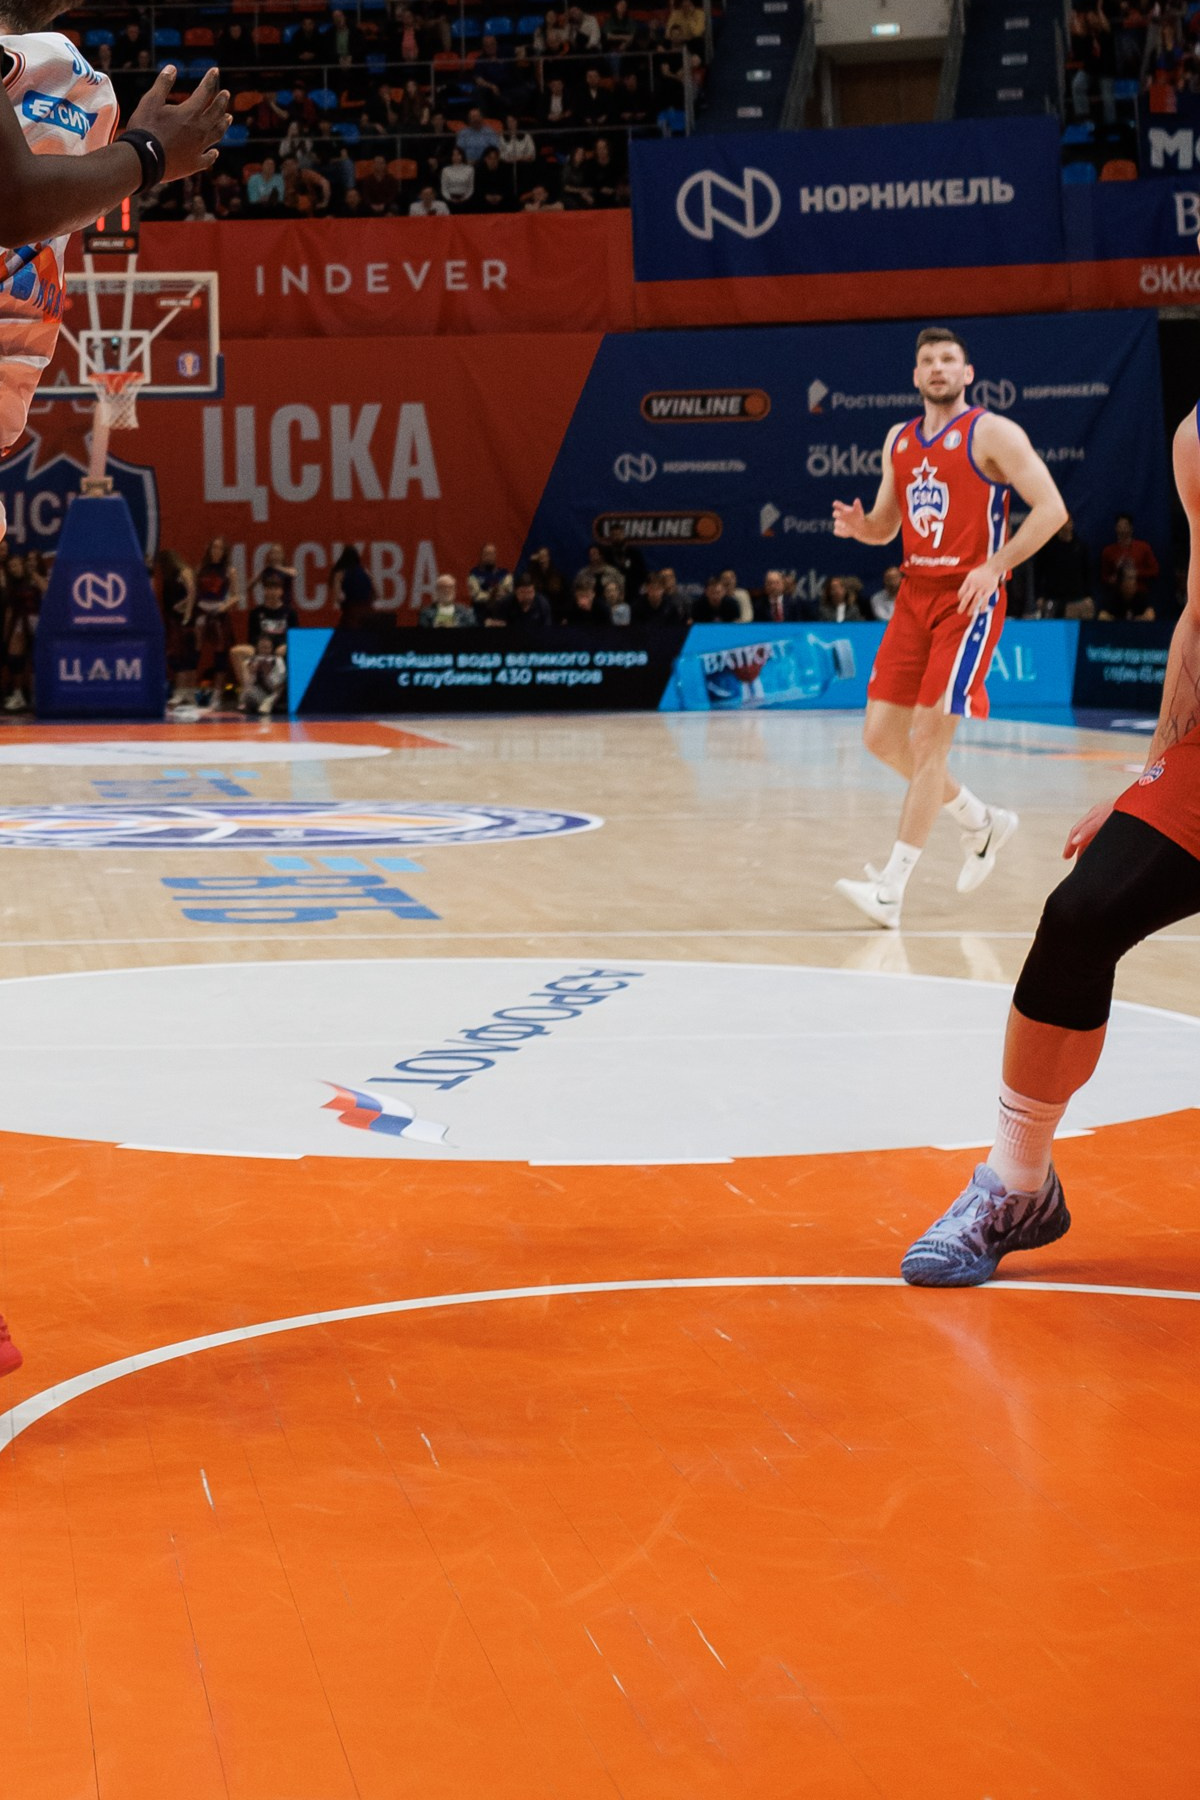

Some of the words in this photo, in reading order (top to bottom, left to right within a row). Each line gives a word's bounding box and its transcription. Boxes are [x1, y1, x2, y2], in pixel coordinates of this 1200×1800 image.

[800, 176, 1015, 213] НОРНИКЕЛЬ
[256, 258, 509, 296] INDEVER
[650, 396, 742, 417] WINLINE
[202, 402, 442, 523] ЦСКА
[930, 522, 944, 549] 7
[59, 658, 142, 683] ЦАМ
[352, 651, 453, 669] Чистейшая
[456, 653, 501, 669] вода
[505, 652, 590, 668] великого
[594, 652, 648, 668] озера
[399, 673, 410, 687] с
[413, 671, 491, 689] глубины
[495, 671, 532, 685] 430
[536, 672, 602, 687] метров
[364, 966, 646, 1091] АЭРОФЛОТ
